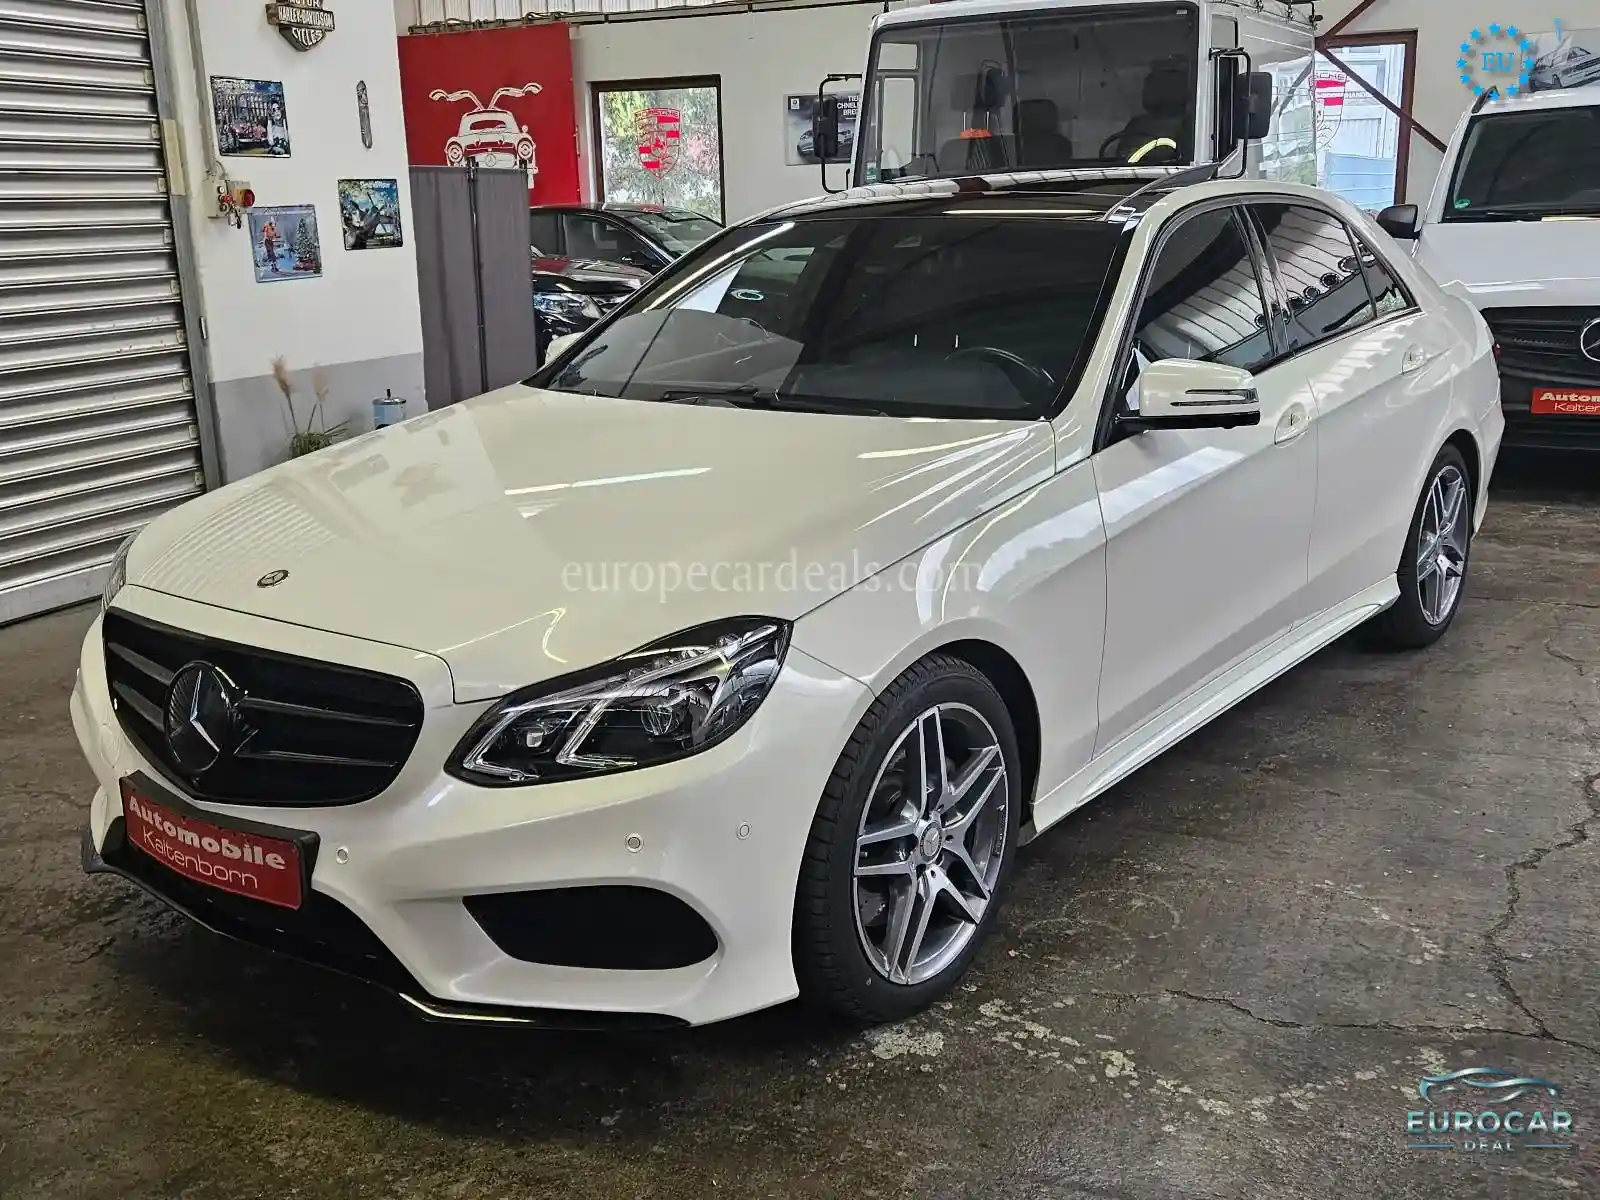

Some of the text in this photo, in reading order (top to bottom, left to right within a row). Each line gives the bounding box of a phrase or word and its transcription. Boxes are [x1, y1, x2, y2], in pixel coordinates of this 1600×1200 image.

[292, 27, 322, 46] CYCLES
[129, 796, 286, 870] Automobile
[142, 827, 258, 889] Kaltenborn
